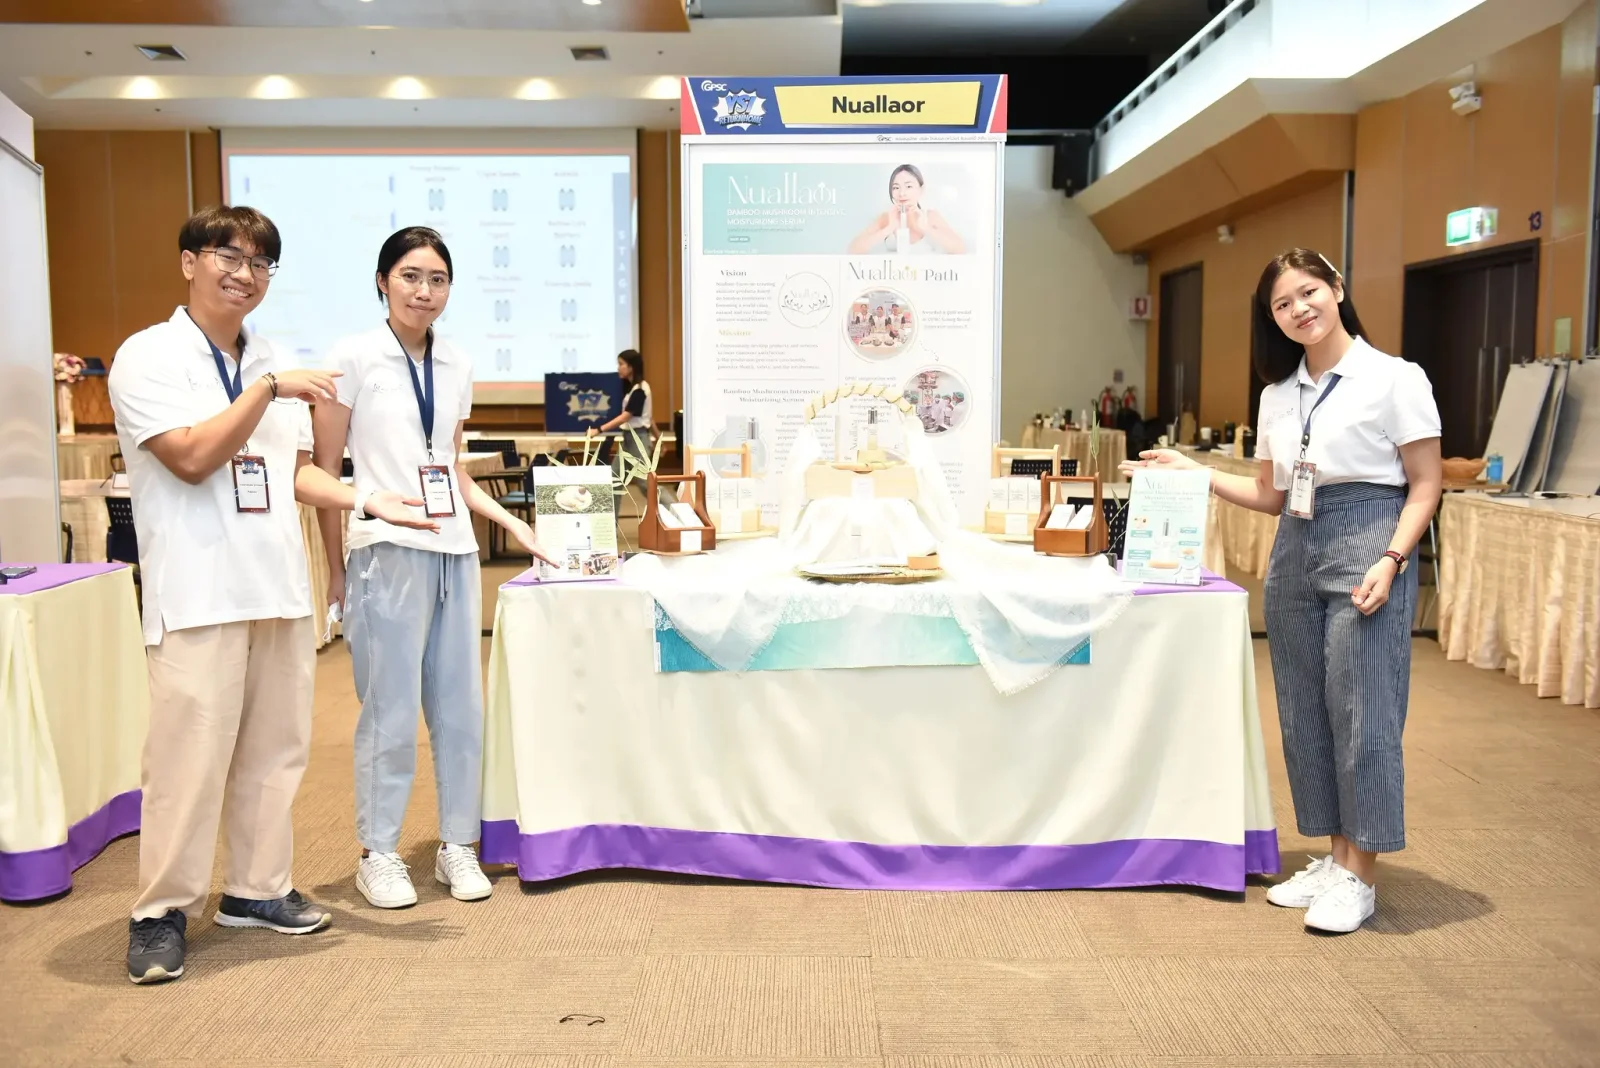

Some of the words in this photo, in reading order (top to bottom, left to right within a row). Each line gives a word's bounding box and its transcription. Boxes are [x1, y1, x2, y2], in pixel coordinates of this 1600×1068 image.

[701, 80, 728, 91] GPSC
[832, 95, 926, 113] Nuallaor
[728, 172, 840, 205] Nuallaor
[727, 208, 760, 216] BAMBOO
[762, 208, 806, 216] MUSHROOM
[720, 269, 747, 277] Vision
[924, 269, 958, 281] Path
[718, 329, 752, 337] Mission
